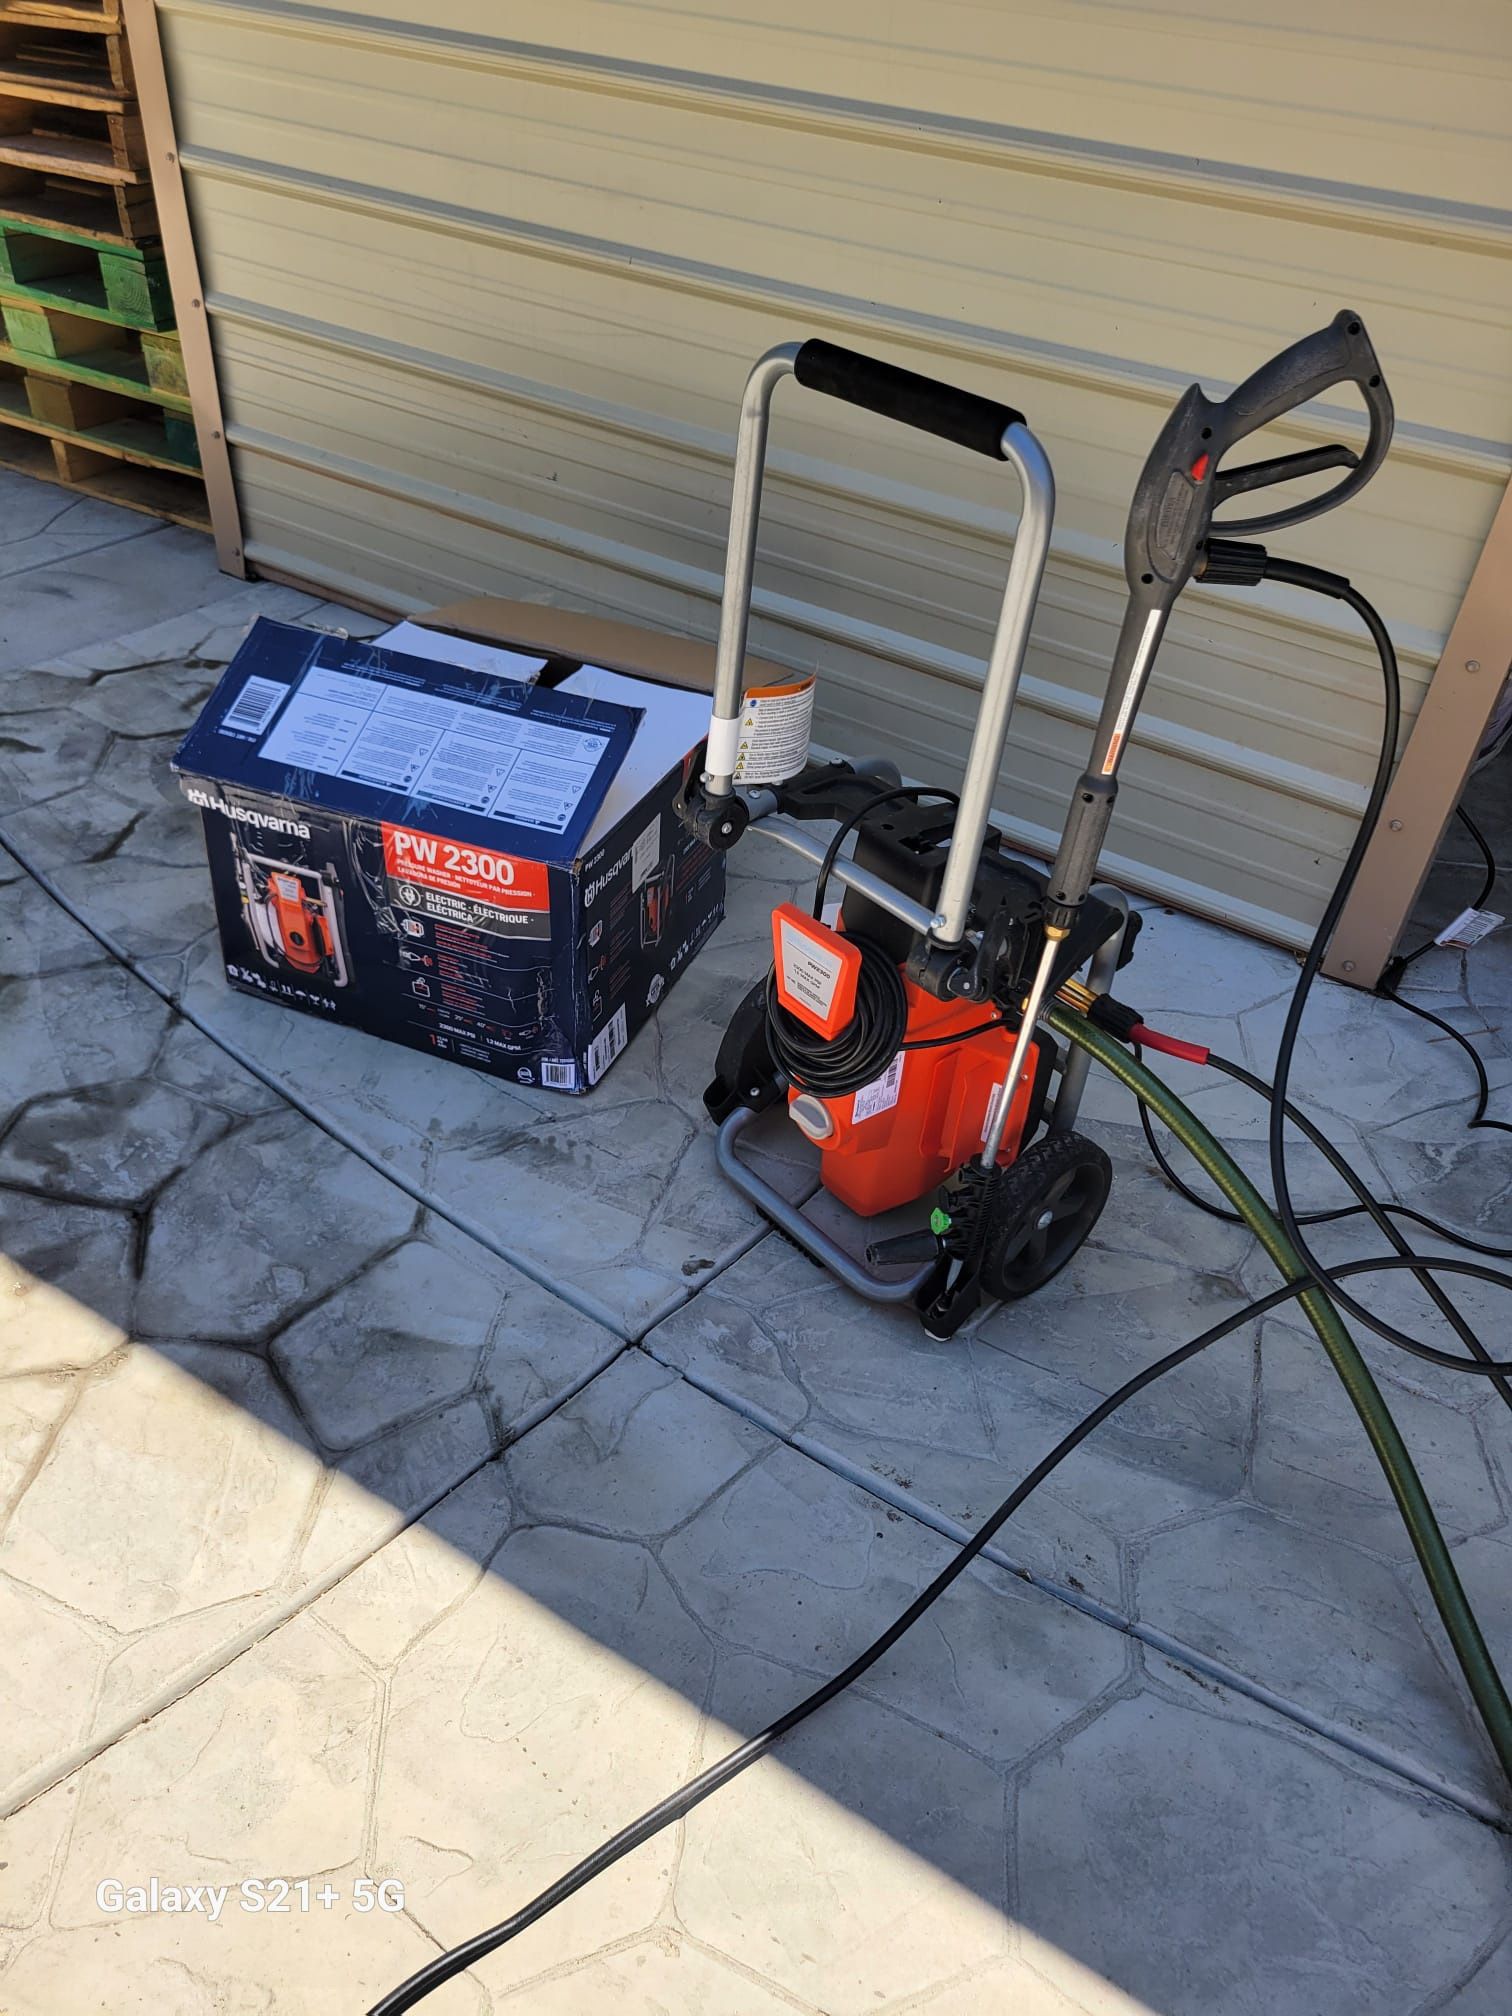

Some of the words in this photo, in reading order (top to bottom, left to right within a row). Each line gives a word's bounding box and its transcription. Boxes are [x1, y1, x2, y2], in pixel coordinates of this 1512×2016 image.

[209, 796, 311, 840] Husqvarna
[393, 830, 437, 865] PW
[442, 845, 515, 886] 2300
[596, 848, 633, 895] Husqvar
[425, 892, 467, 911] ELECTRIC
[473, 904, 529, 924] ÉLECTRIQUE
[426, 902, 474, 923] ELÉCTRICA
